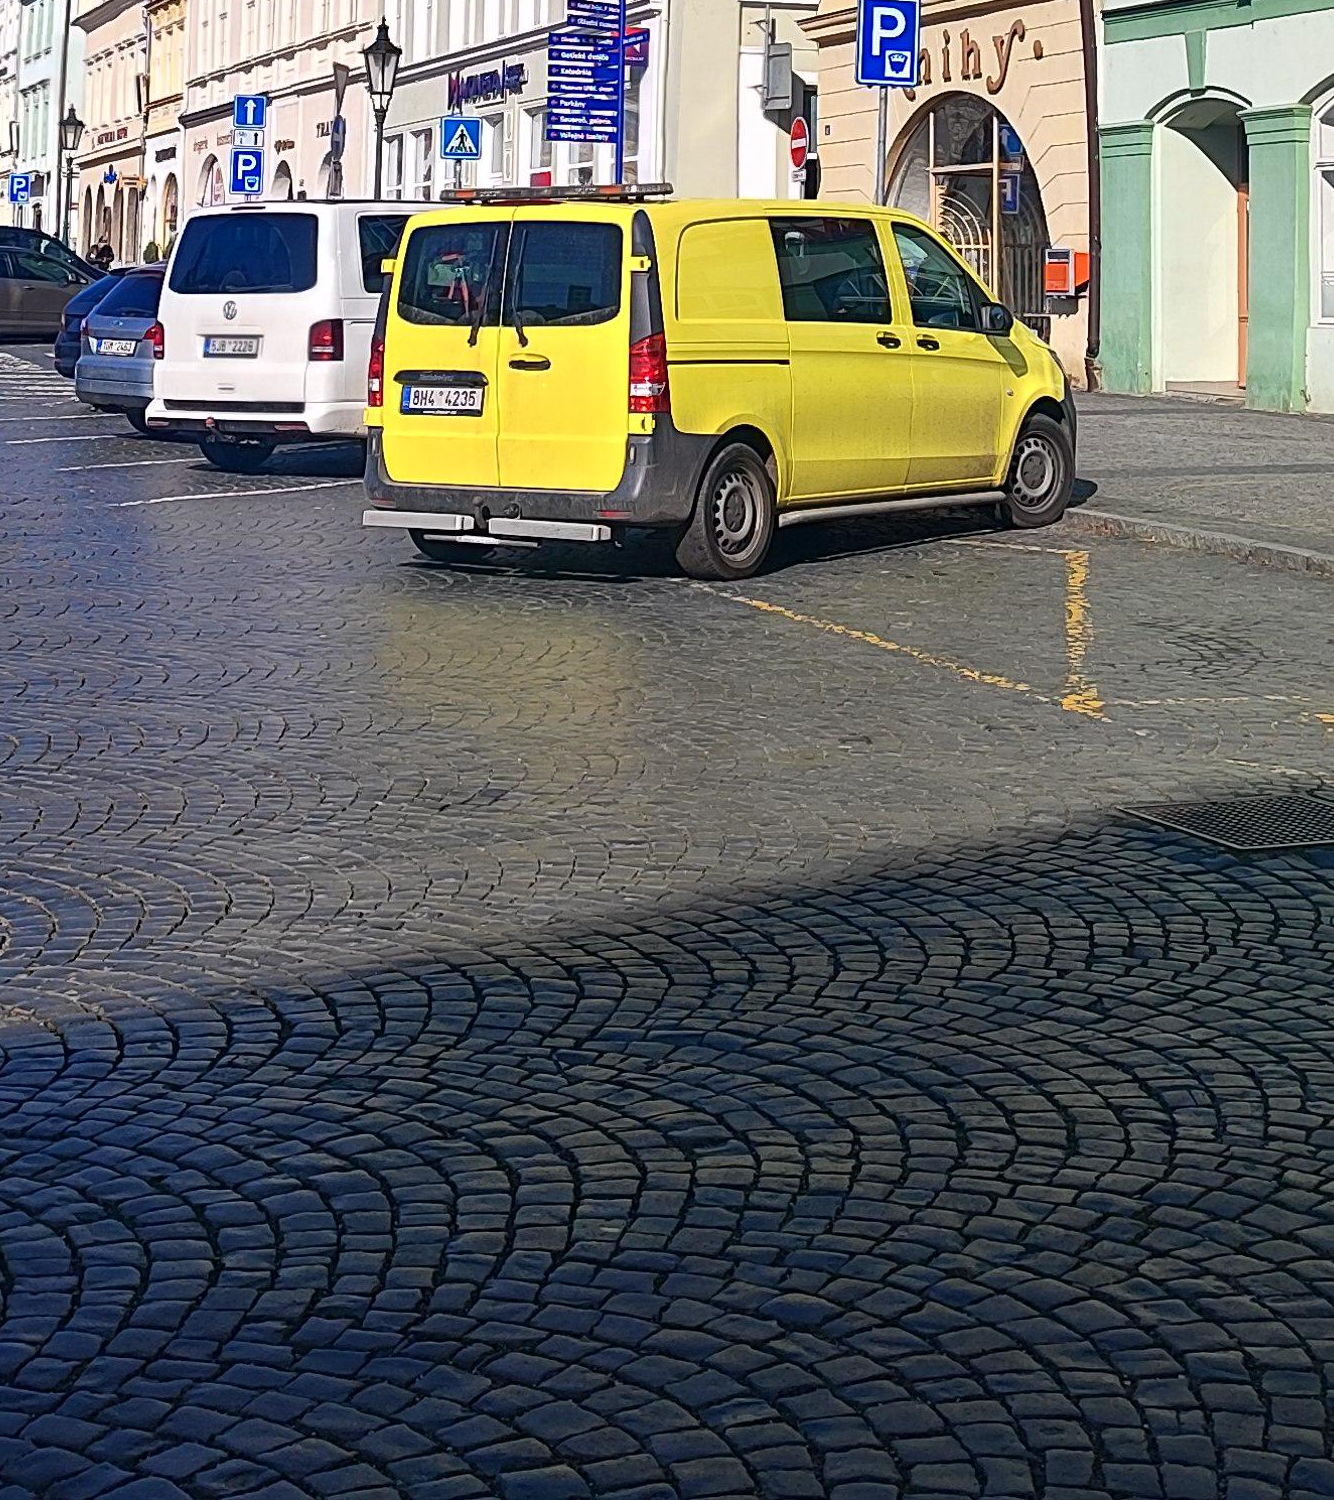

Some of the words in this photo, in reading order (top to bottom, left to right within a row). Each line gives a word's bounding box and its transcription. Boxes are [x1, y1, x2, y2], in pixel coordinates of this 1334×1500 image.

[871, 6, 906, 56] P
[904, 19, 1025, 101] nihy
[238, 154, 257, 180] P
[13, 177, 26, 195] P
[412, 389, 435, 406] 8H4
[445, 390, 476, 407] 4235
